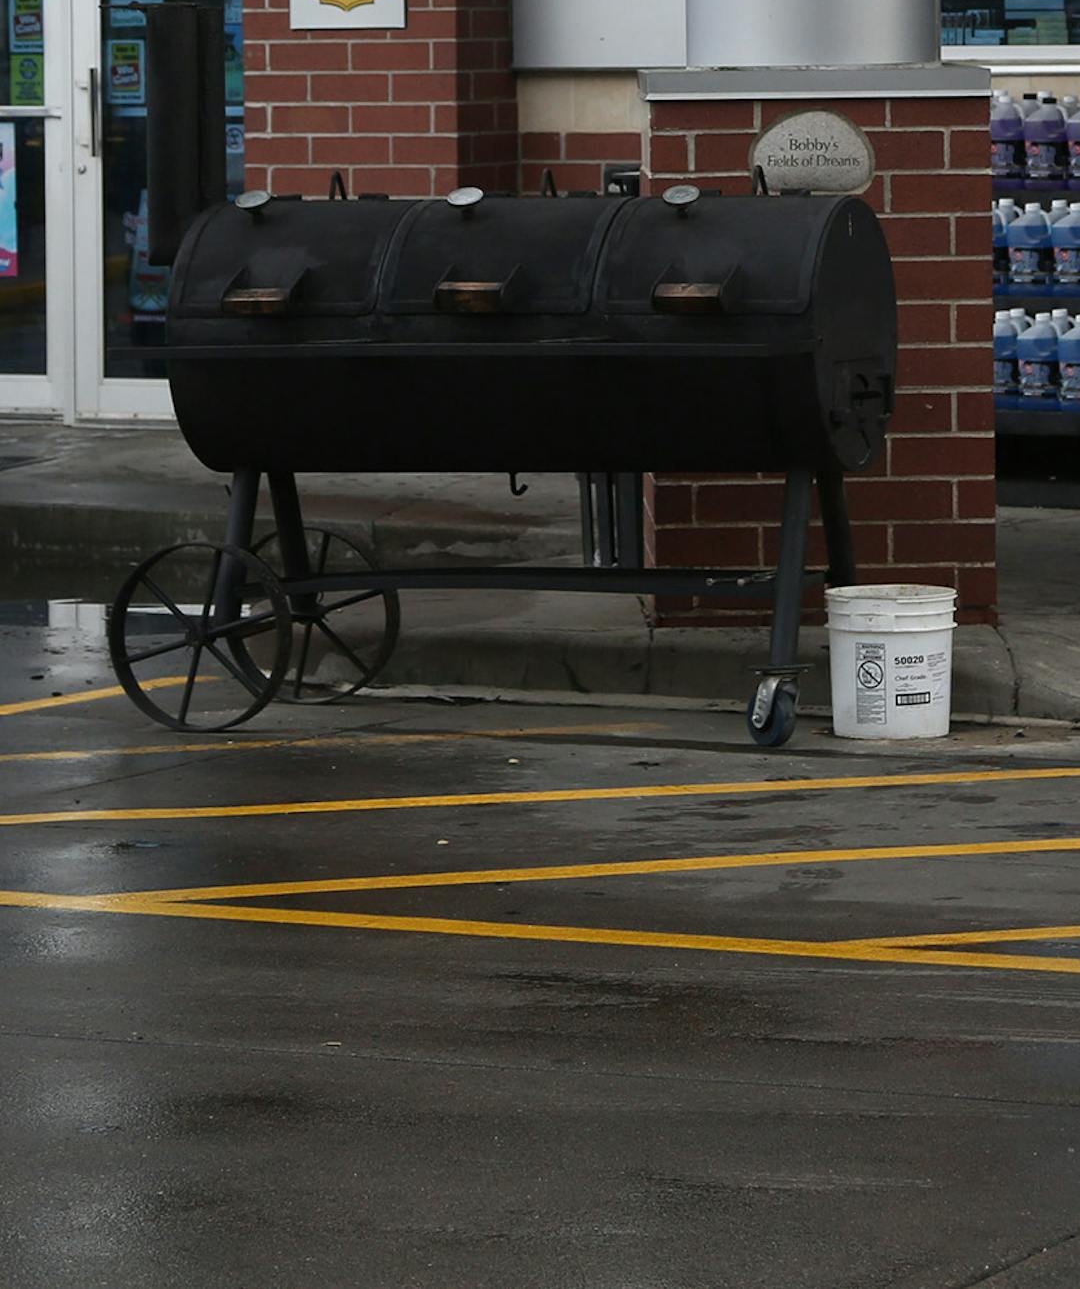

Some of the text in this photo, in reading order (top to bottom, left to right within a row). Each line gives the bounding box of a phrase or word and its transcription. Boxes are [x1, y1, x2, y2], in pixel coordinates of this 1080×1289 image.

[789, 136, 839, 153] Bobby's
[767, 154, 861, 167] Fields of Dreams
[894, 655, 925, 665] 50020
